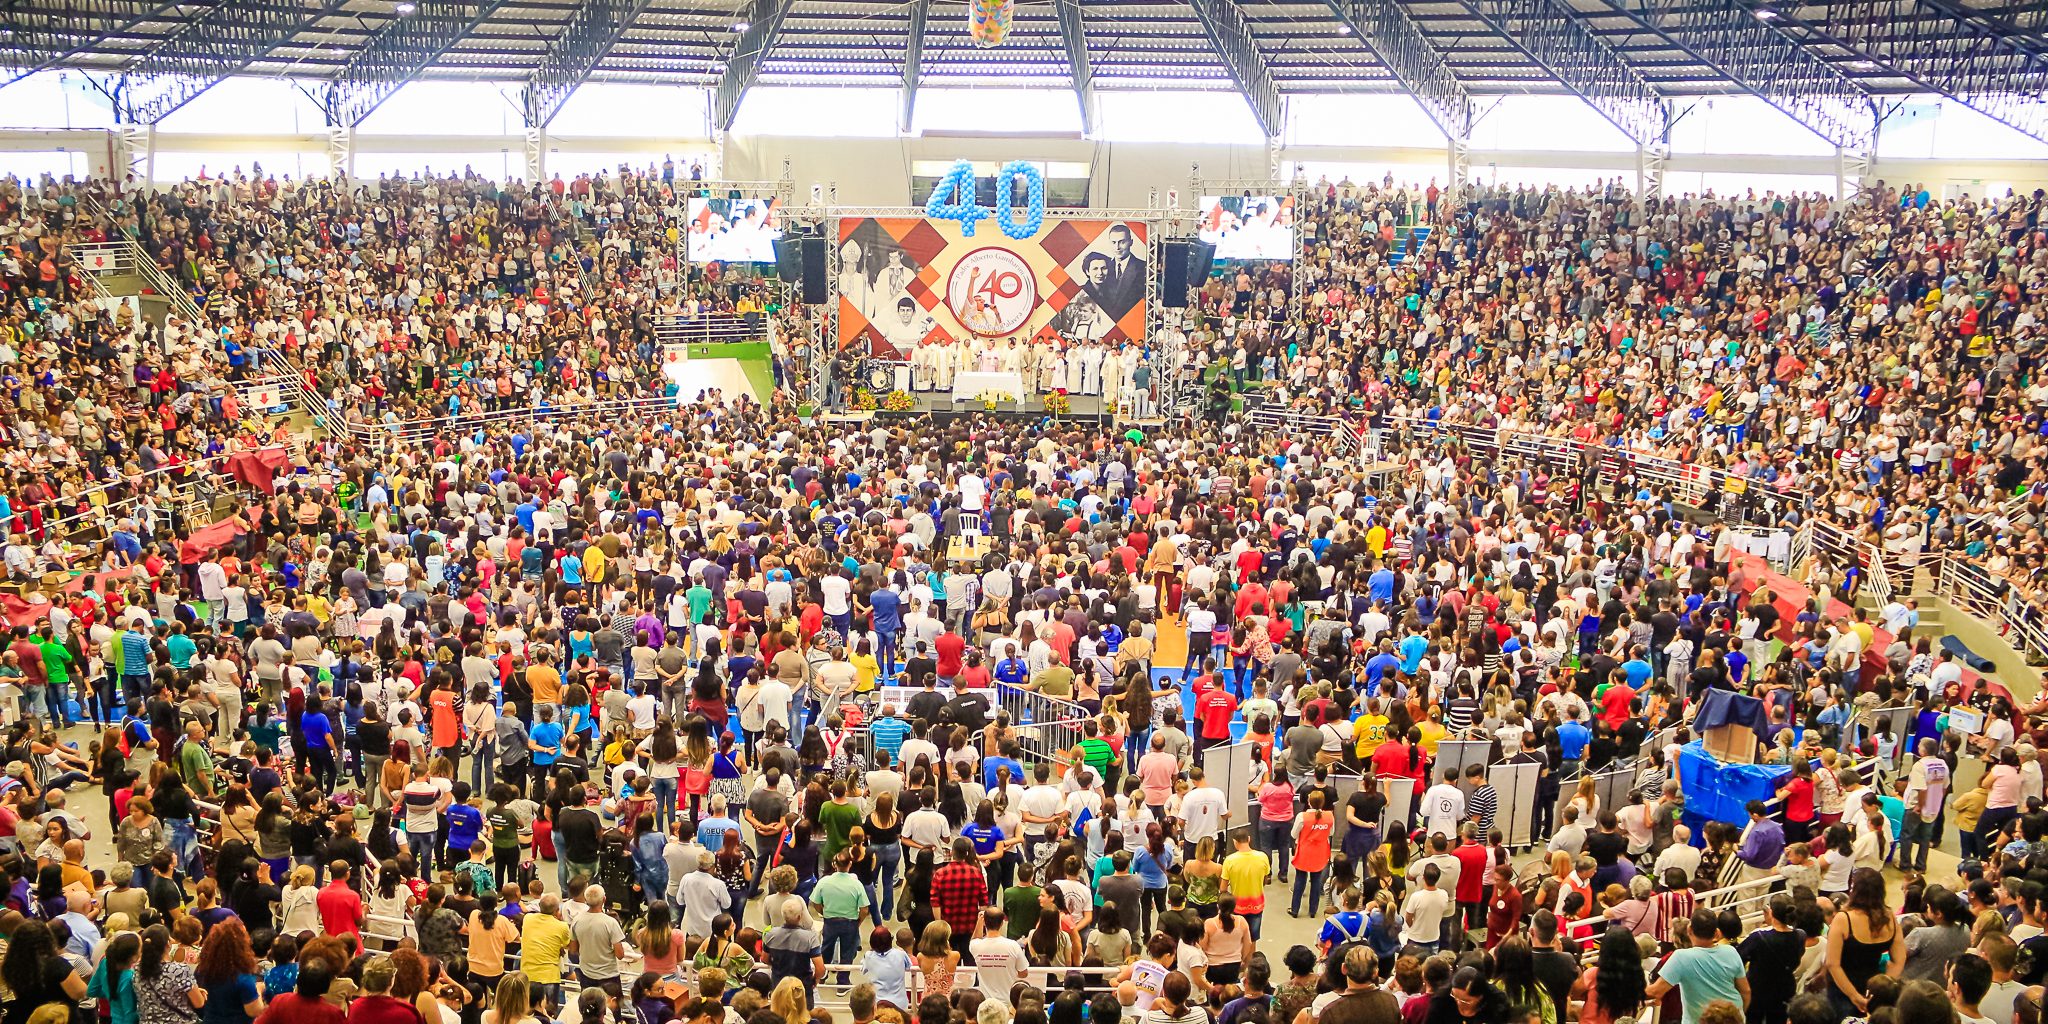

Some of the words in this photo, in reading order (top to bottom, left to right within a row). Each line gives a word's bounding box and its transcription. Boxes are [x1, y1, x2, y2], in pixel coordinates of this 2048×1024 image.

[926, 159, 1043, 240] 40
[970, 253, 994, 264] Alberto
[978, 269, 1022, 304] 40
